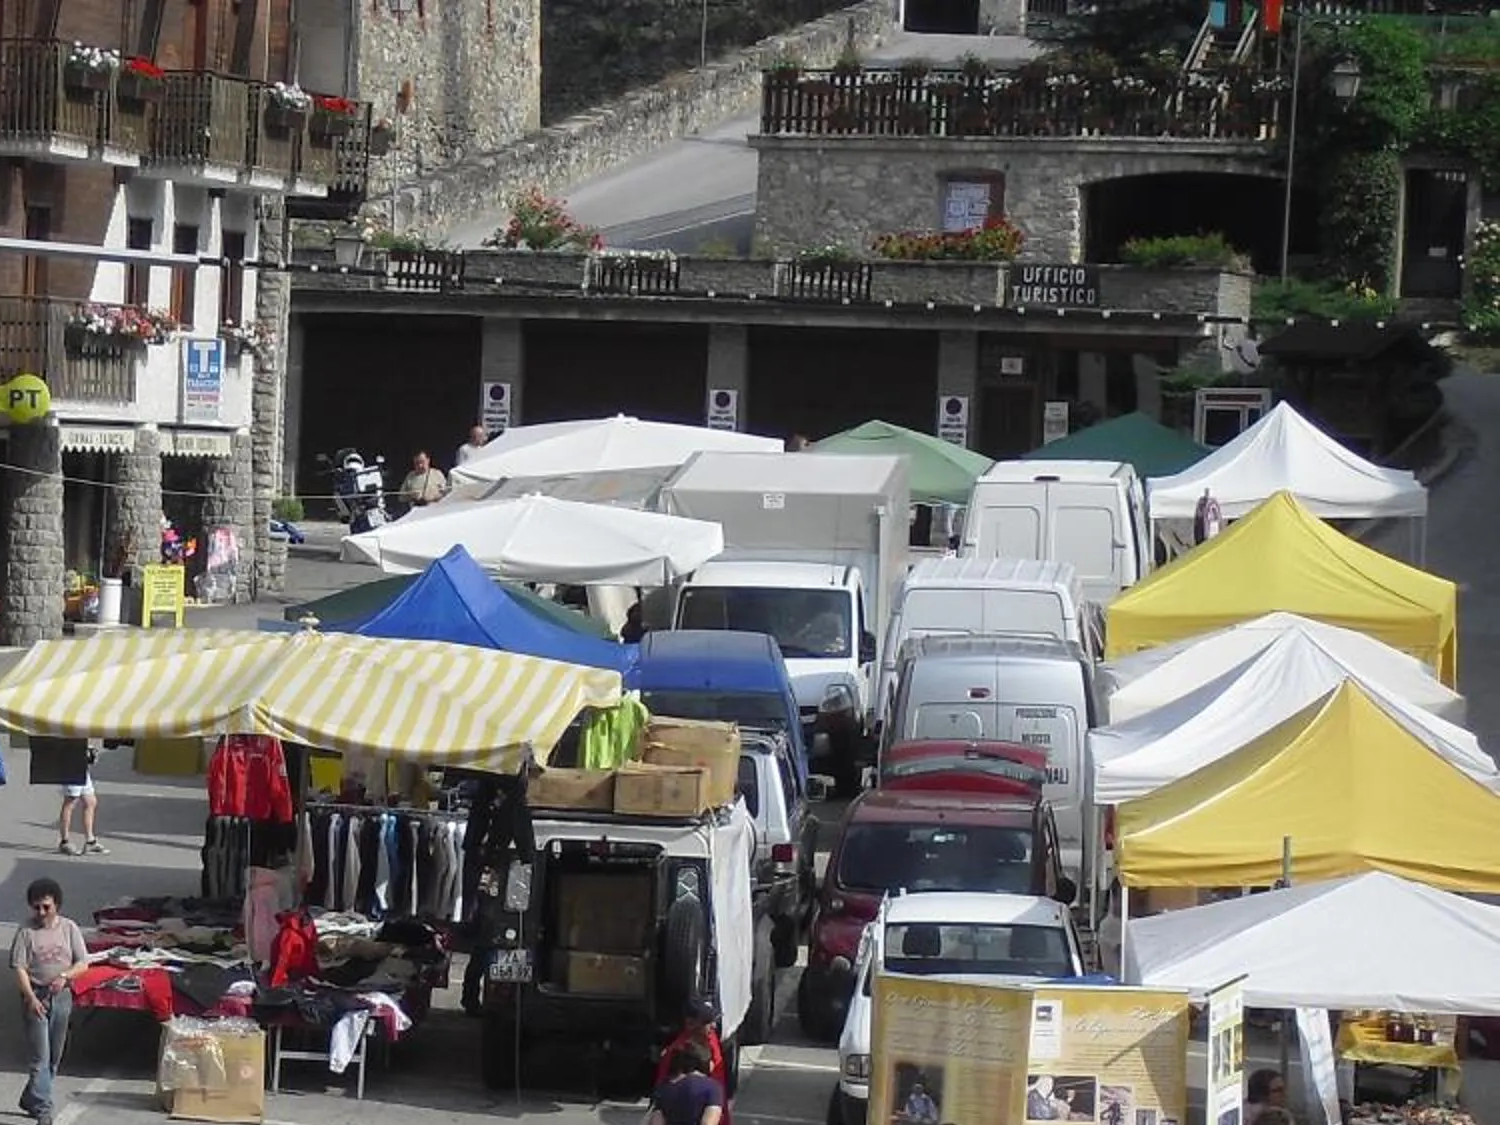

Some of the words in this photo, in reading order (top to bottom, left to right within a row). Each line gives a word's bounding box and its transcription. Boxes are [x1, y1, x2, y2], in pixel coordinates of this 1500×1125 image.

[1022, 266, 1086, 285] UFFICIO
[1011, 285, 1096, 305] TURISTICO
[9, 389, 42, 409] PT
